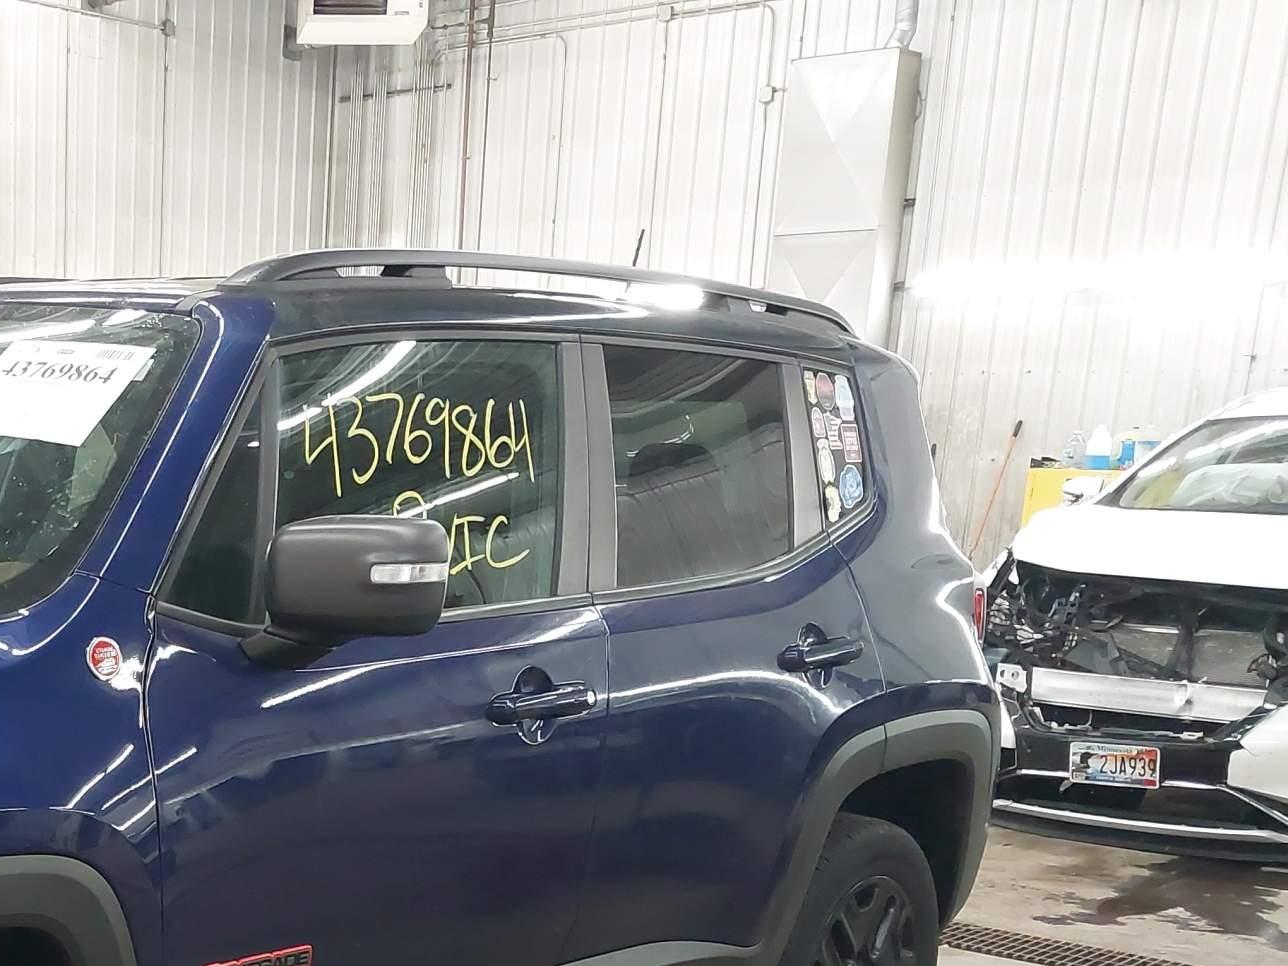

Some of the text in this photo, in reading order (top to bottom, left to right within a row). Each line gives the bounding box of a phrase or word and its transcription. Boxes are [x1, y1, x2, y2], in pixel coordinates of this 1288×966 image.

[2, 359, 119, 384] 43769864
[302, 392, 535, 498] 43769864
[1100, 755, 1157, 778] 2JA939
